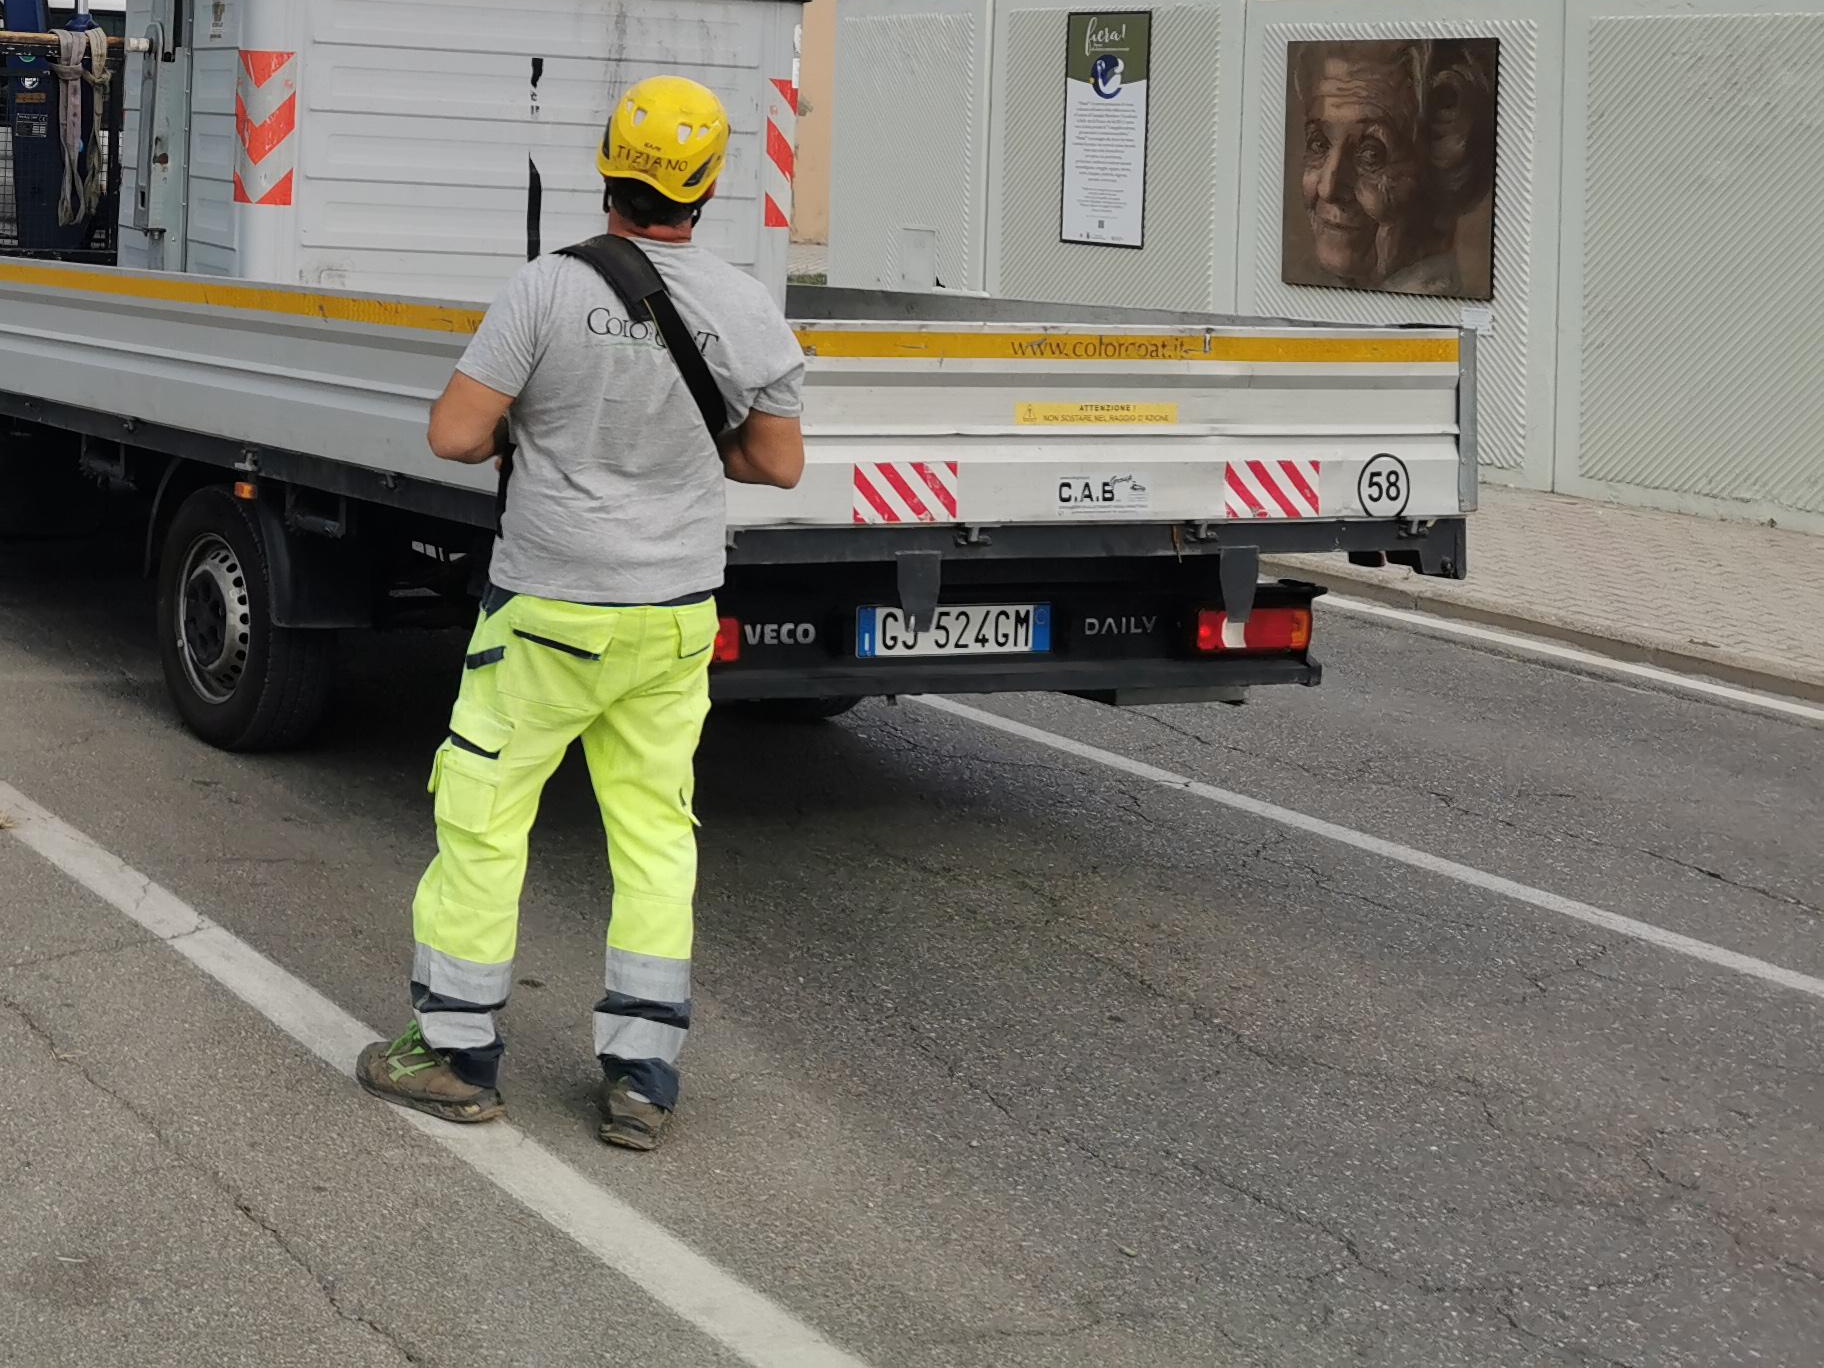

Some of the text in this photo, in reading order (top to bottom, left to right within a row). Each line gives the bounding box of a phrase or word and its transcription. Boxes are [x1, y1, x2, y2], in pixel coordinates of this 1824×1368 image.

[617, 144, 688, 172] TIZIANO
[1010, 334, 1185, 359] www.colorcoat.it
[1043, 414, 1059, 422] NON
[1061, 414, 1092, 422] SOSTARE
[1094, 414, 1109, 422] NEL
[1368, 470, 1401, 503] 58
[934, 609, 1031, 649] 524GM
[1083, 616, 1157, 635] DAILY
